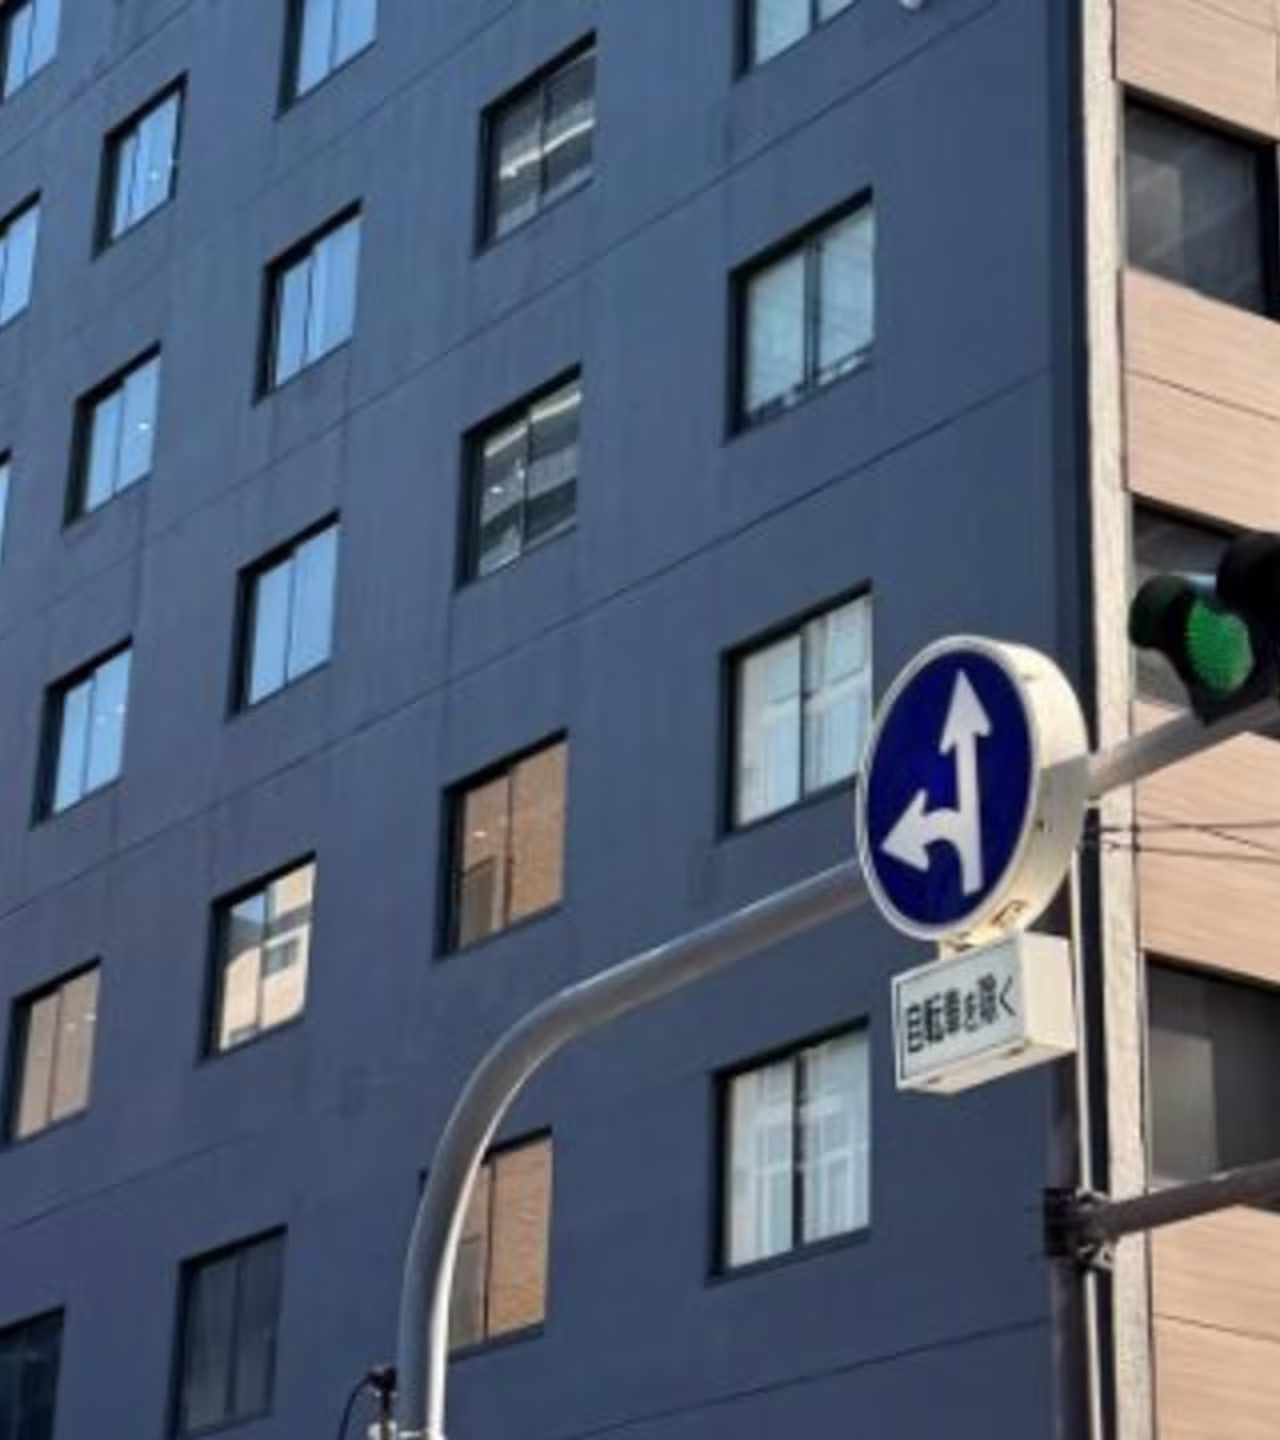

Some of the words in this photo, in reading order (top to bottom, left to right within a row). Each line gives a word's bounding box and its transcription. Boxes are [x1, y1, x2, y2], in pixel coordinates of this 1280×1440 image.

[906, 972, 1017, 1054] 自転車を除く
